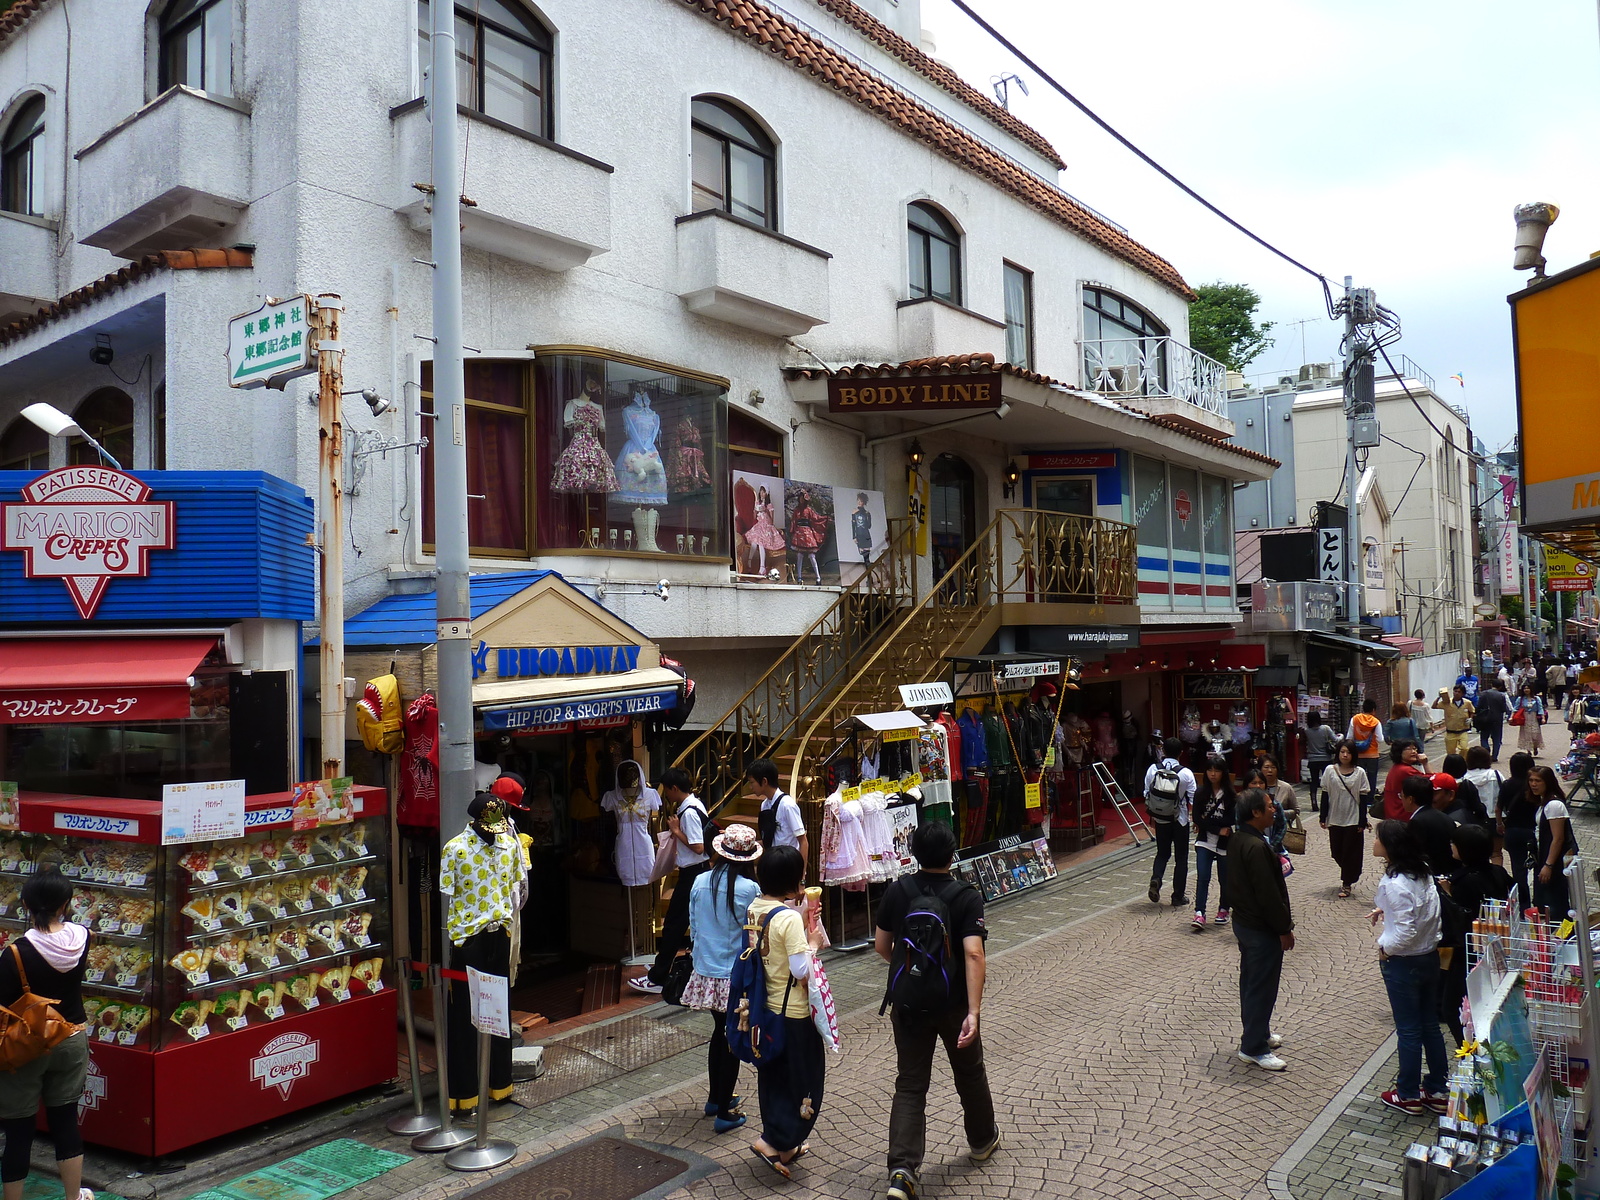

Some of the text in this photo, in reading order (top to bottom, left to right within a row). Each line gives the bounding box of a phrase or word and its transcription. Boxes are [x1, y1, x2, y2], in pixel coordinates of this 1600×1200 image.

[243, 306, 303, 339] 東郷神社
[243, 330, 303, 361] 東郷記念館
[838, 383, 991, 406] BODY LINE
[36, 469, 138, 497] PATISSERIE
[1571, 480, 1600, 510] M
[16, 511, 161, 539] MARION
[1504, 531, 1513, 582] NO FALL
[451, 626, 459, 635] 9
[497, 645, 642, 678] BROADWAY
[2, 697, 138, 718] マリオンクレープ
[909, 686, 948, 703] JIMSINN
[506, 695, 661, 728] HIP HOP & SPORTS WEAR
[63, 814, 130, 833] マリオンクレープ
[266, 1034, 306, 1052] PATISSERIE
[257, 1046, 315, 1074] MARION
